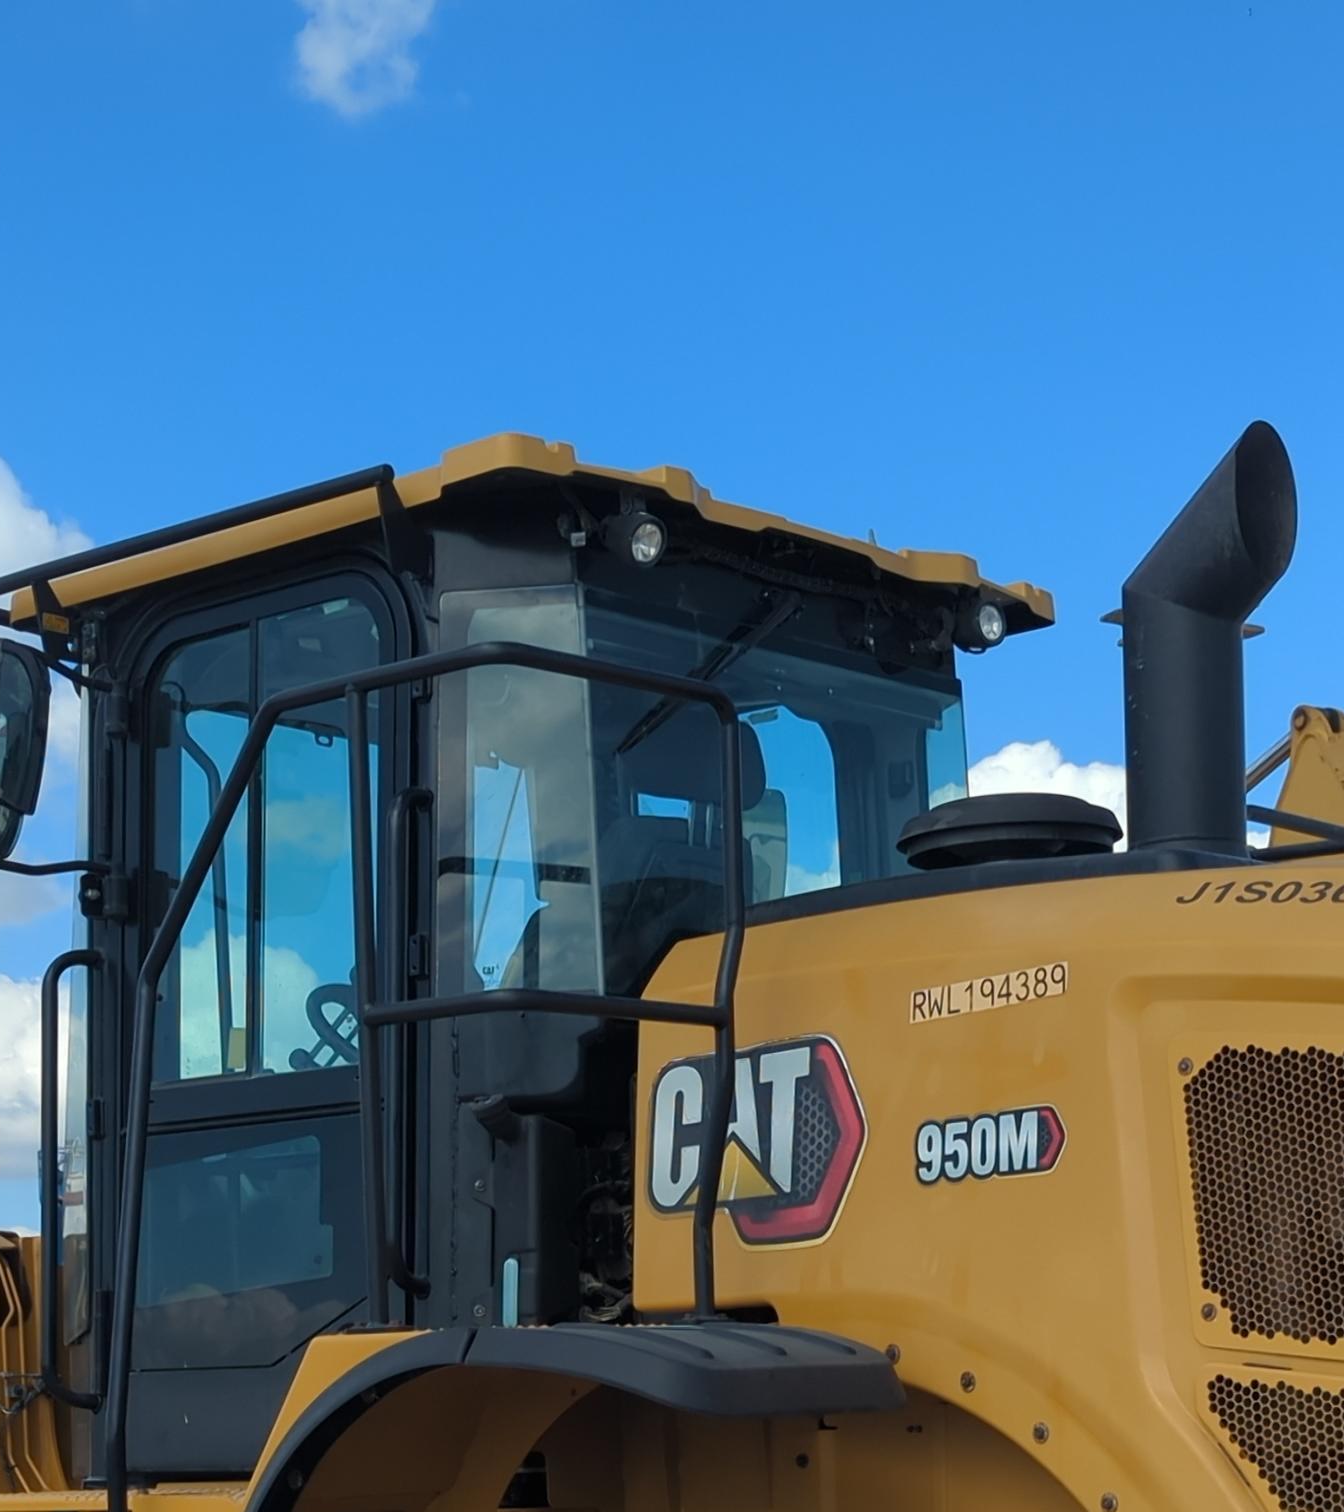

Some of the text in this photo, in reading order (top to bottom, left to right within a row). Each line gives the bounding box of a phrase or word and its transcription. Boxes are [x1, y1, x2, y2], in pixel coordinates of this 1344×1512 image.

[912, 964, 1067, 1022] RWL194389
[652, 1046, 811, 1207] CAT
[917, 1110, 1039, 1182] 950M
